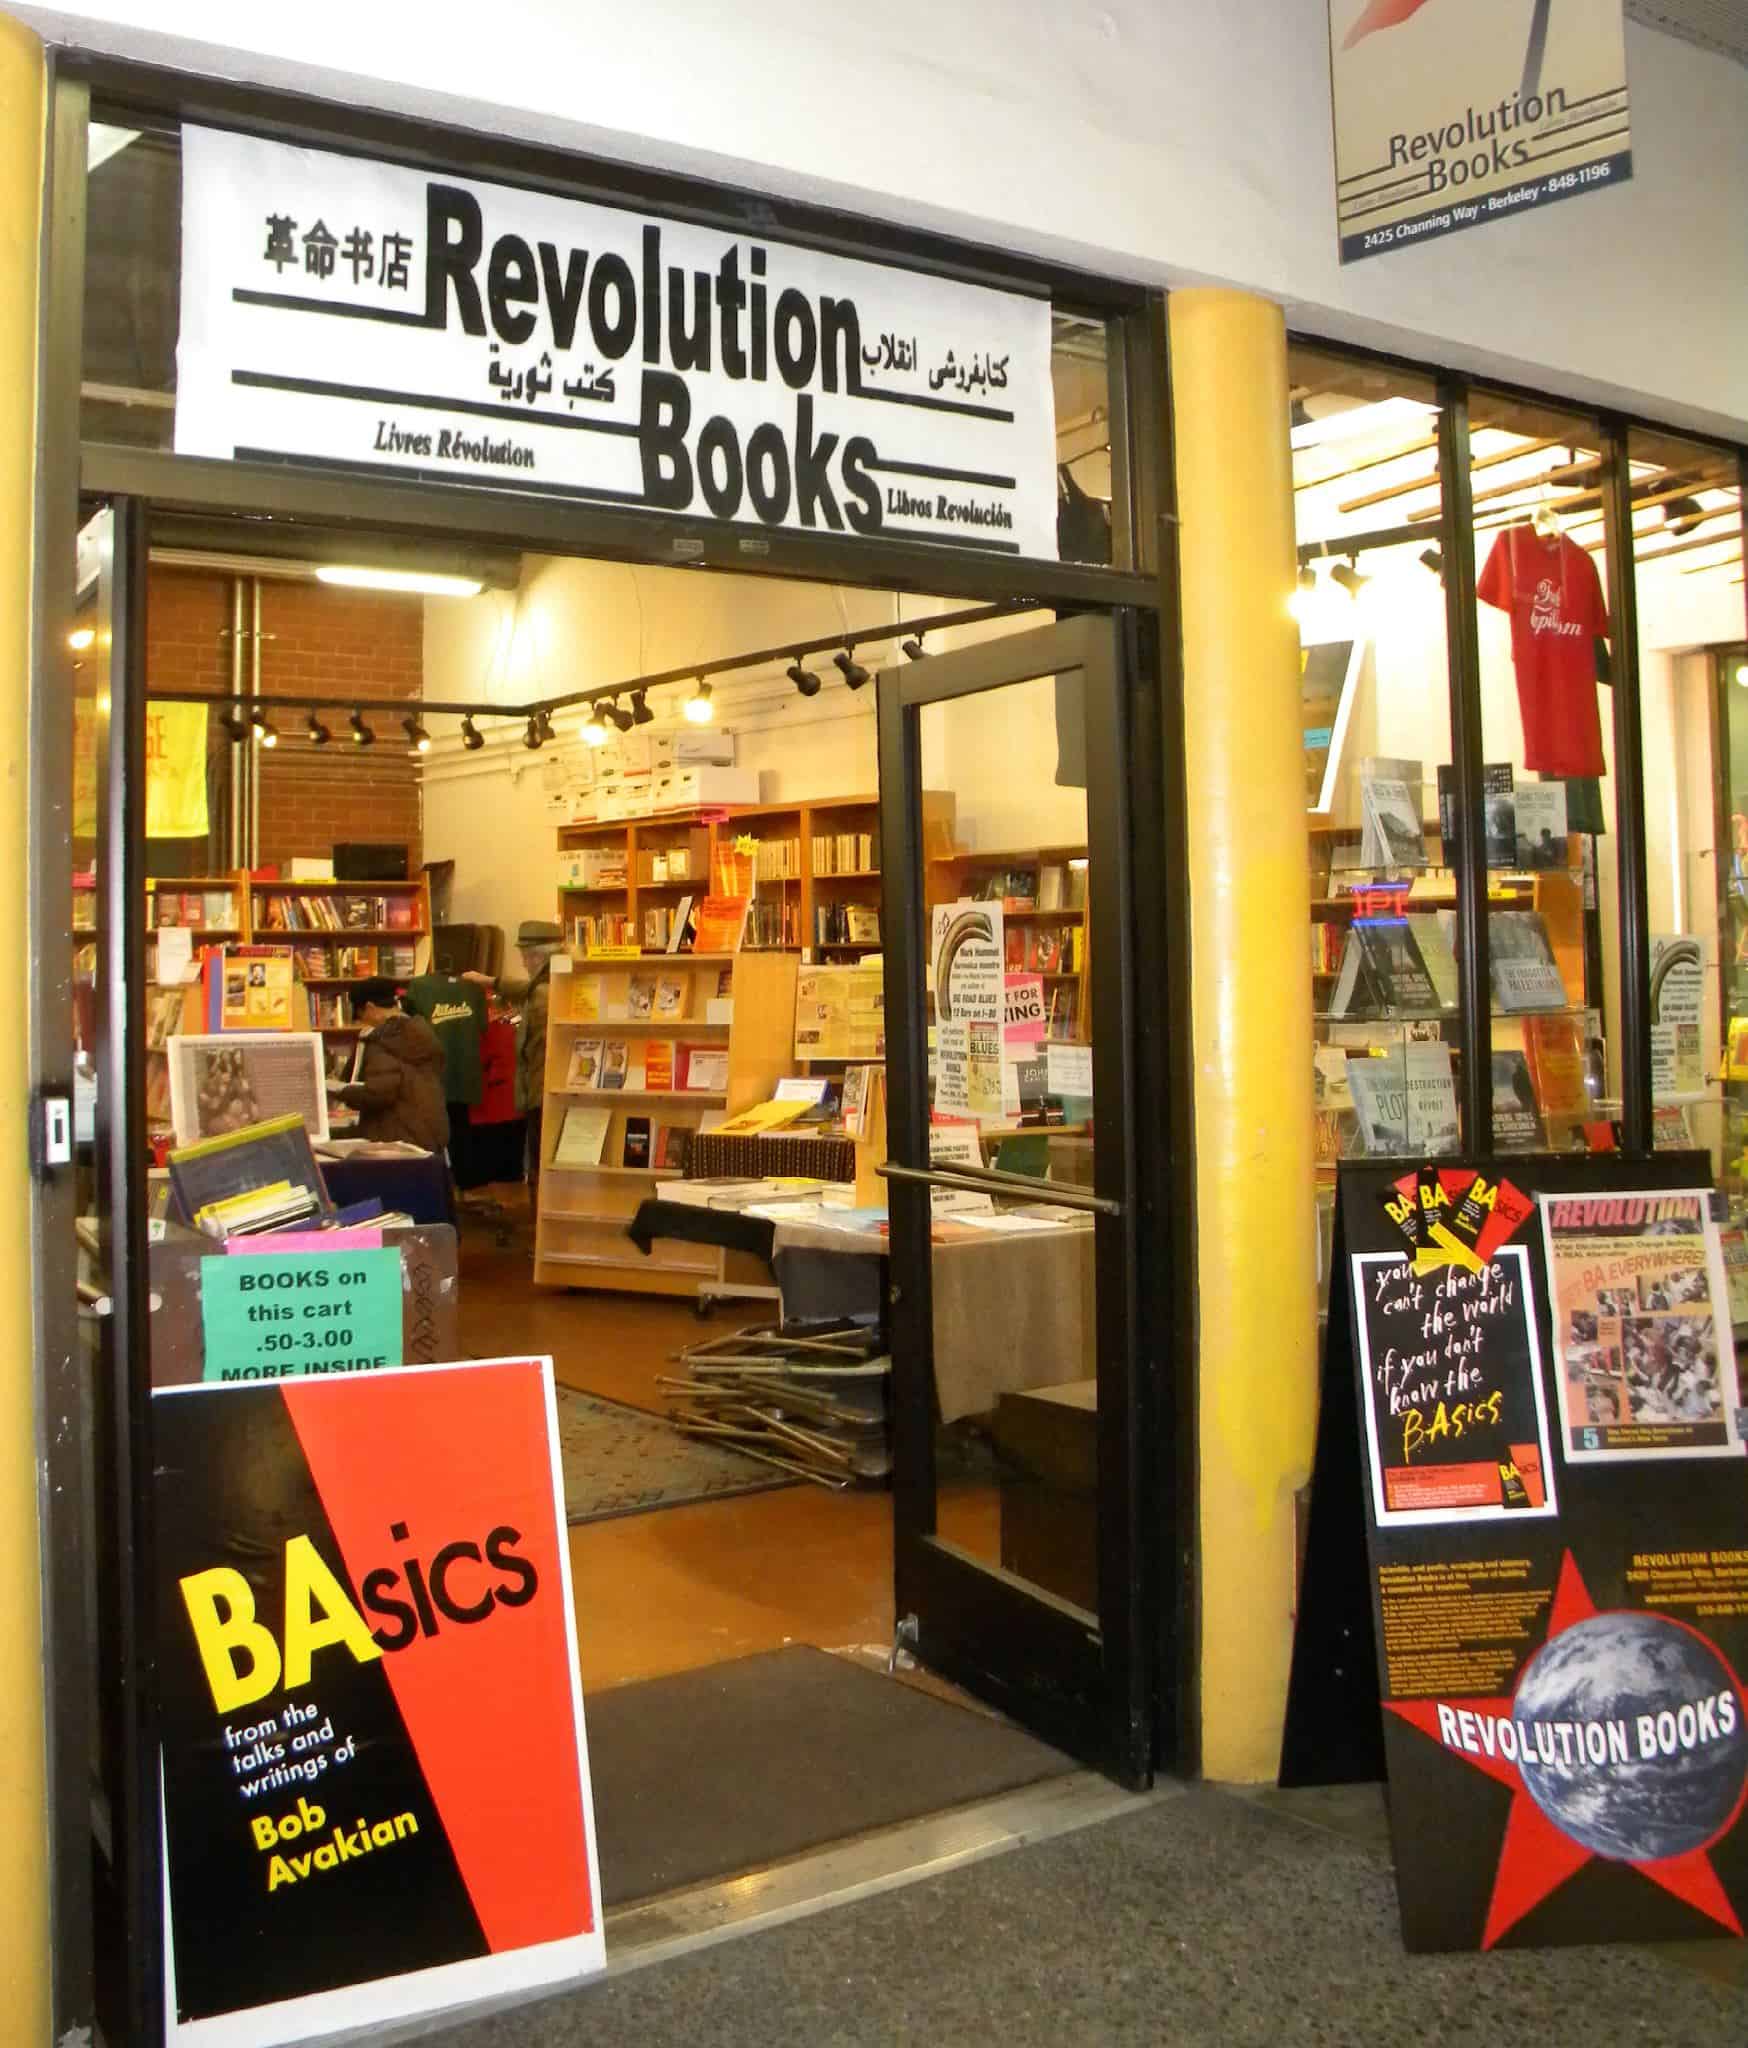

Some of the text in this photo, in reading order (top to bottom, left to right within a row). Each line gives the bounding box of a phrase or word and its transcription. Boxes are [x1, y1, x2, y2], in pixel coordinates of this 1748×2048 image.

[1389, 87, 1566, 168] Revolution
[1427, 138, 1529, 193] Books
[1364, 161, 1611, 249] 2425 Channing Way Berkeley 848-1196
[264, 213, 414, 290] 革命书店
[426, 182, 861, 396] Revolution
[563, 364, 616, 410] كتب
[373, 421, 535, 468] Livres Révolution
[640, 368, 884, 537] Books
[887, 488, 1013, 529] Libros Revolución
[970, 1042, 1000, 1055] BLUES
[1552, 1196, 1699, 1227] REVOLUTION
[239, 1270, 367, 1291] BOOKS on
[1376, 1264, 1413, 1301] you
[1383, 1264, 1504, 1315] can't change
[1583, 1265, 1605, 1290] BA
[248, 1300, 353, 1321] this cart
[1421, 1281, 1513, 1338] the world
[256, 1329, 353, 1352] .50-3.00
[1377, 1324, 1484, 1395] if you don't
[221, 1356, 387, 1381] MORE INSIDE
[1390, 1355, 1483, 1415] know the
[1583, 1429, 1600, 1450] 5
[1633, 1552, 1708, 1567] REVOLUTION
[224, 1703, 319, 1750] from the
[232, 1718, 335, 1774] talks and
[1436, 1690, 1737, 1766] REVOLUTION BOOKS
[239, 1735, 357, 1799] writings of
[250, 1797, 327, 1851] Bob
[267, 1811, 419, 1892] Avakian
